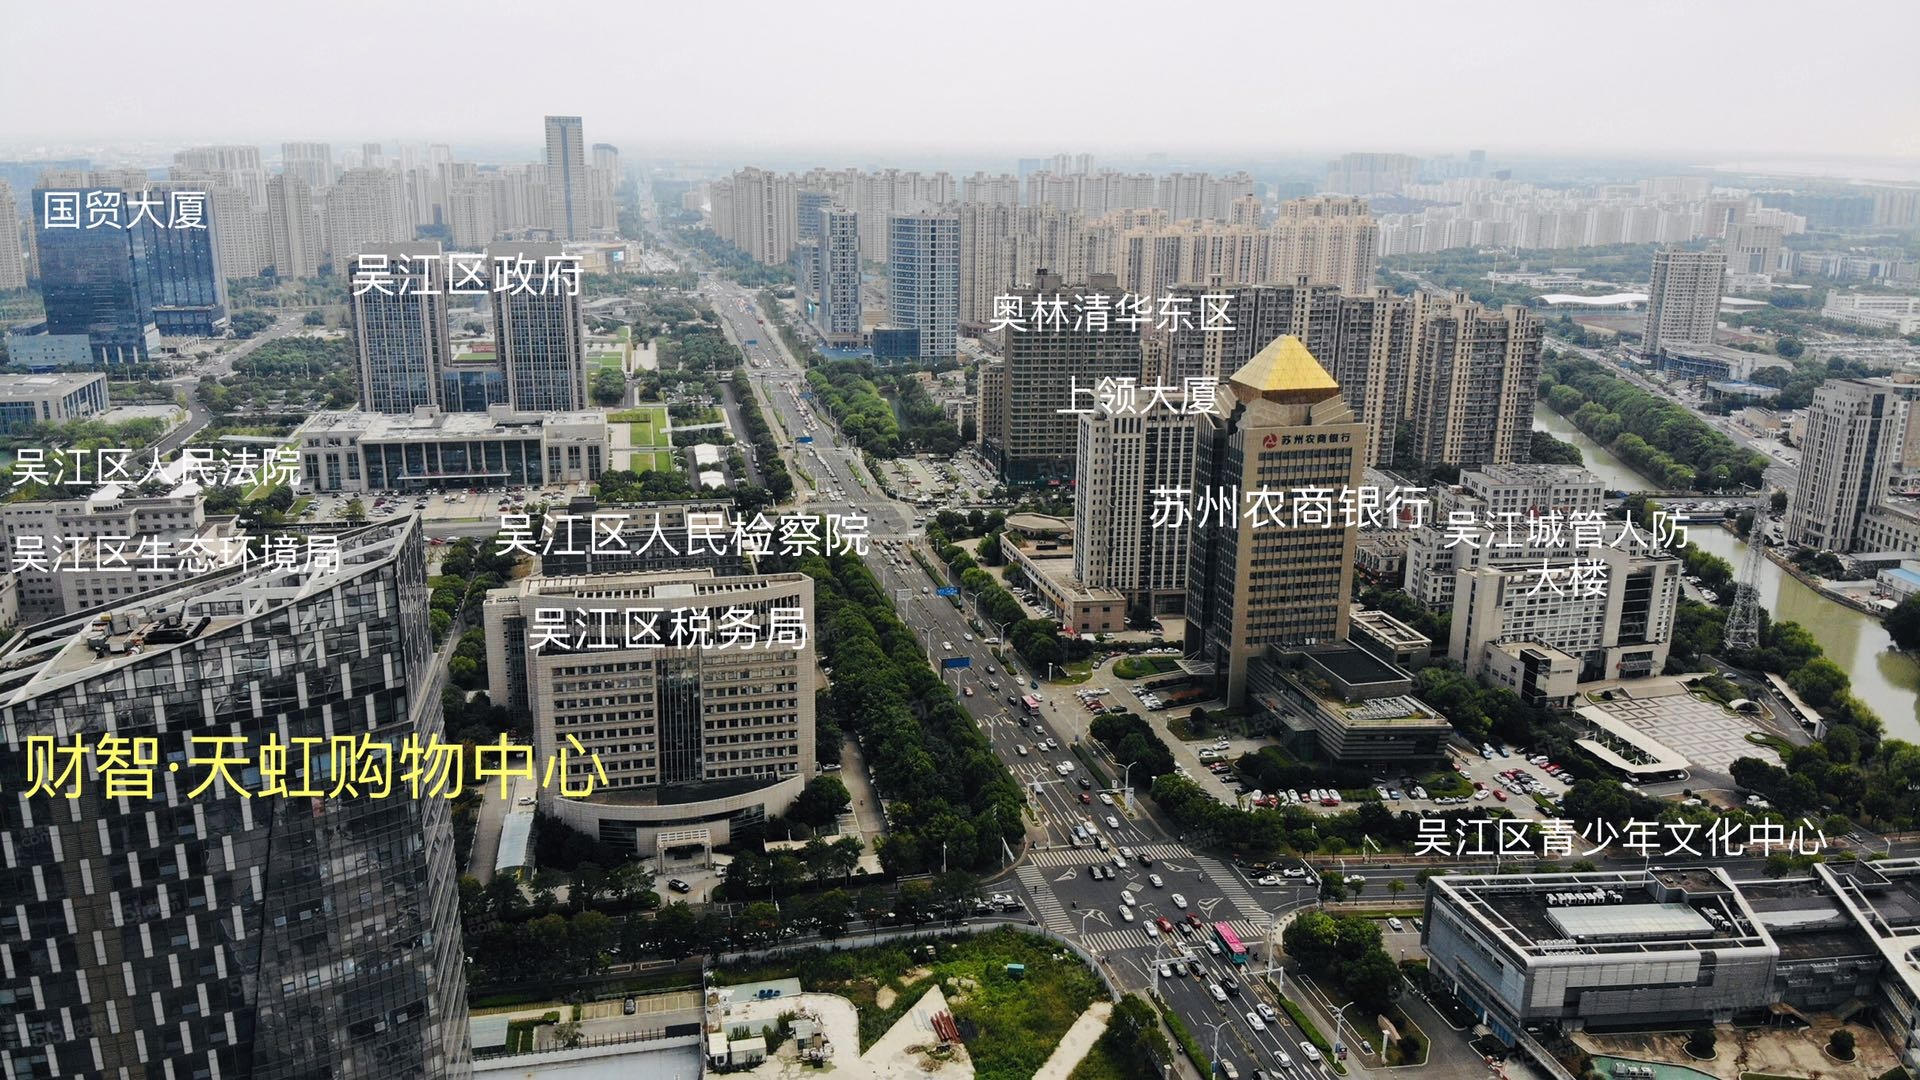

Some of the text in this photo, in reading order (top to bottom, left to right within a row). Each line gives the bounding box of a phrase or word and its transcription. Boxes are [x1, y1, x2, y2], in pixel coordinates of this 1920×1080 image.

[1281, 432, 1351, 446] 苏州农商银行
